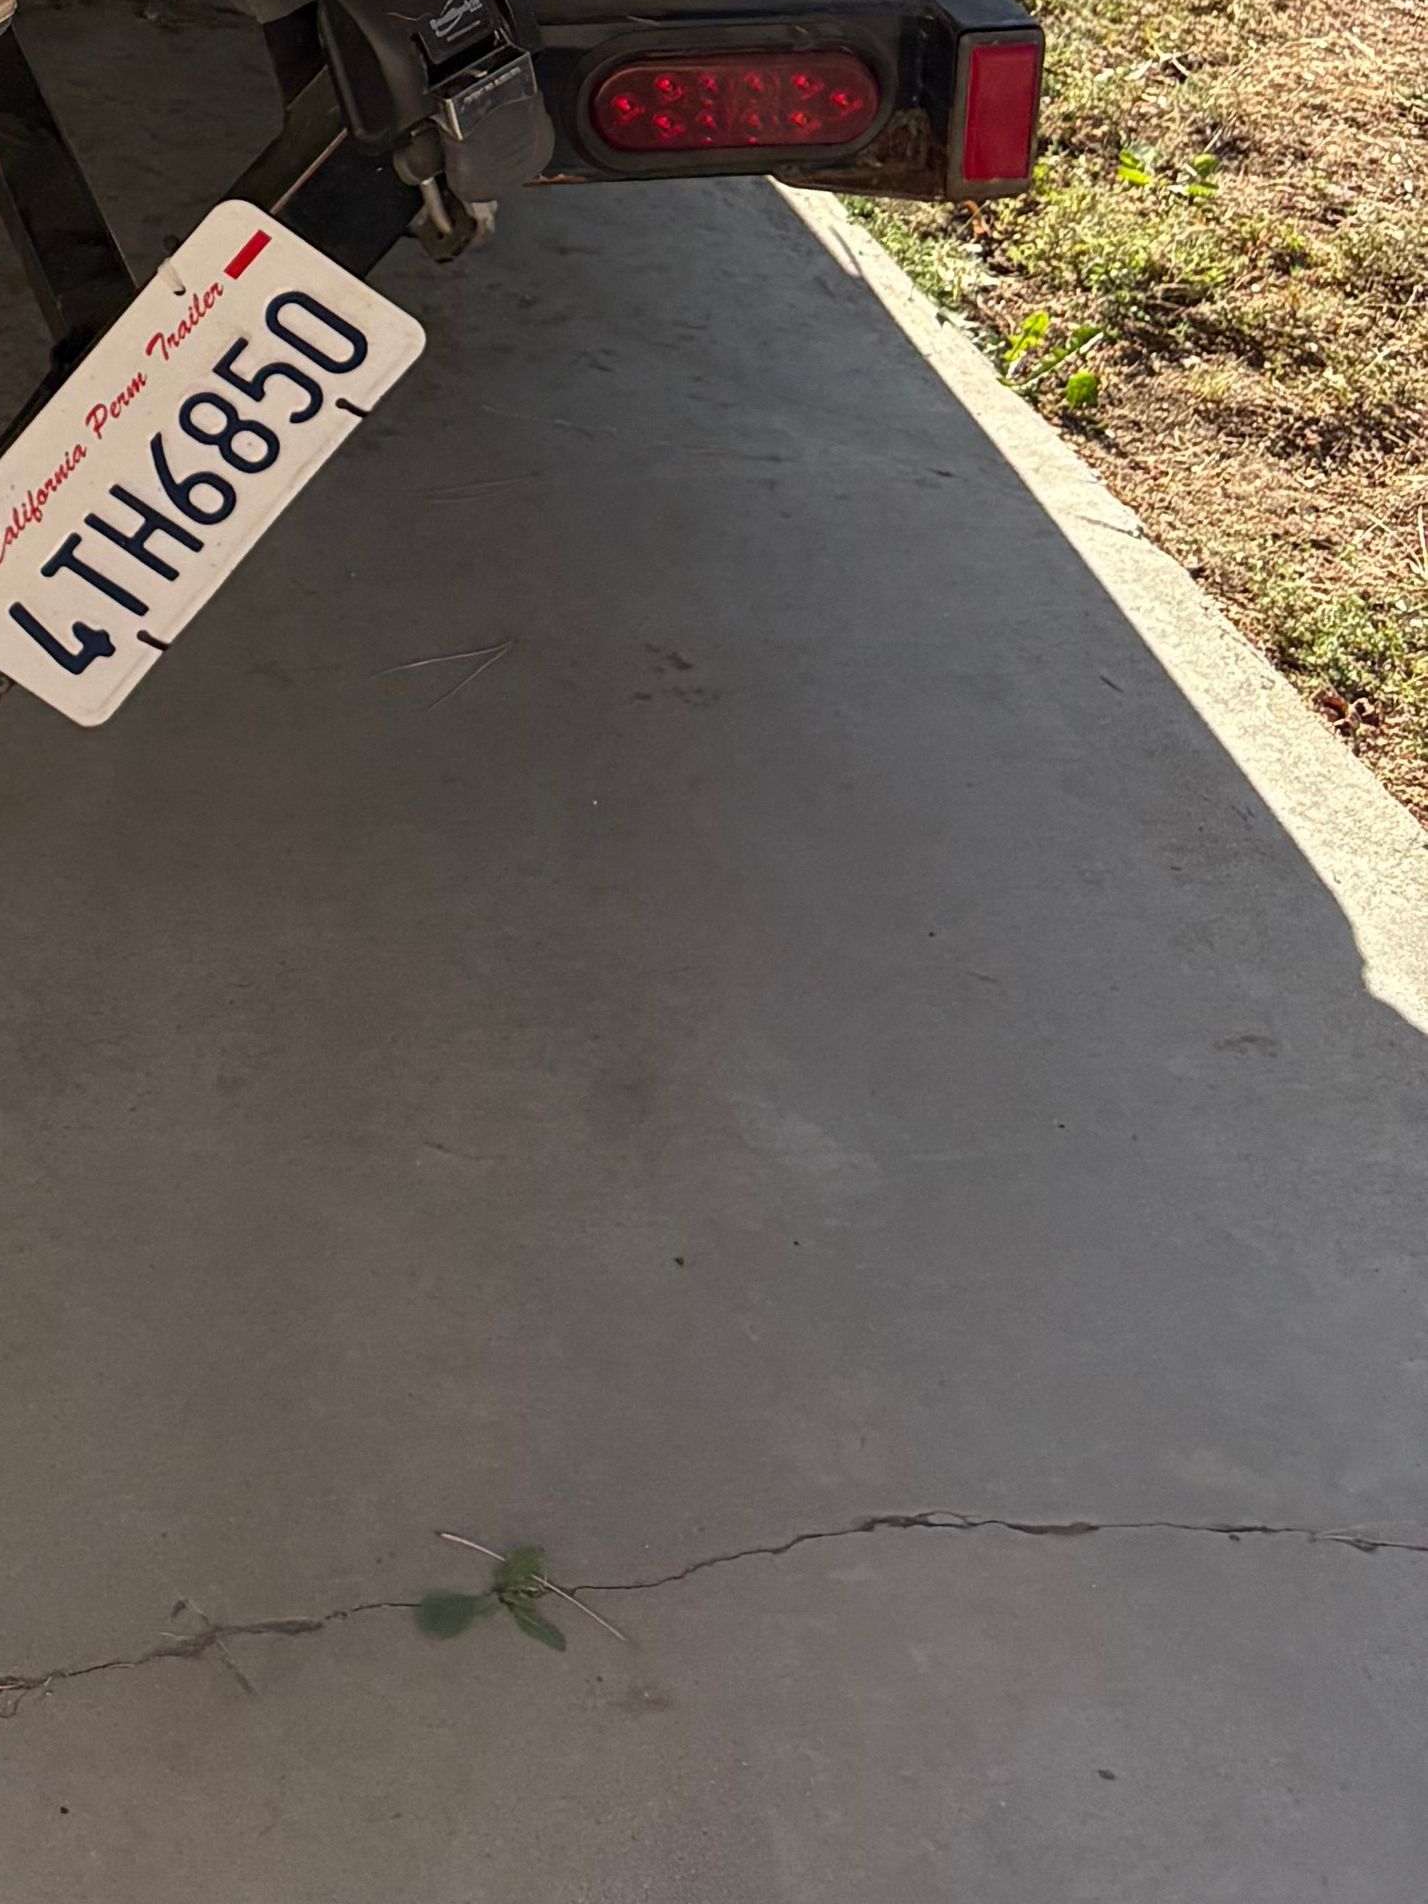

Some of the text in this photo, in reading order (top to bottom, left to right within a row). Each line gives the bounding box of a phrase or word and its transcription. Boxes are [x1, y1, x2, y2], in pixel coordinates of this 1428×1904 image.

[8, 290, 370, 676] 4TH6850
[84, 369, 148, 440] Perm
[145, 281, 225, 361] Trailer
